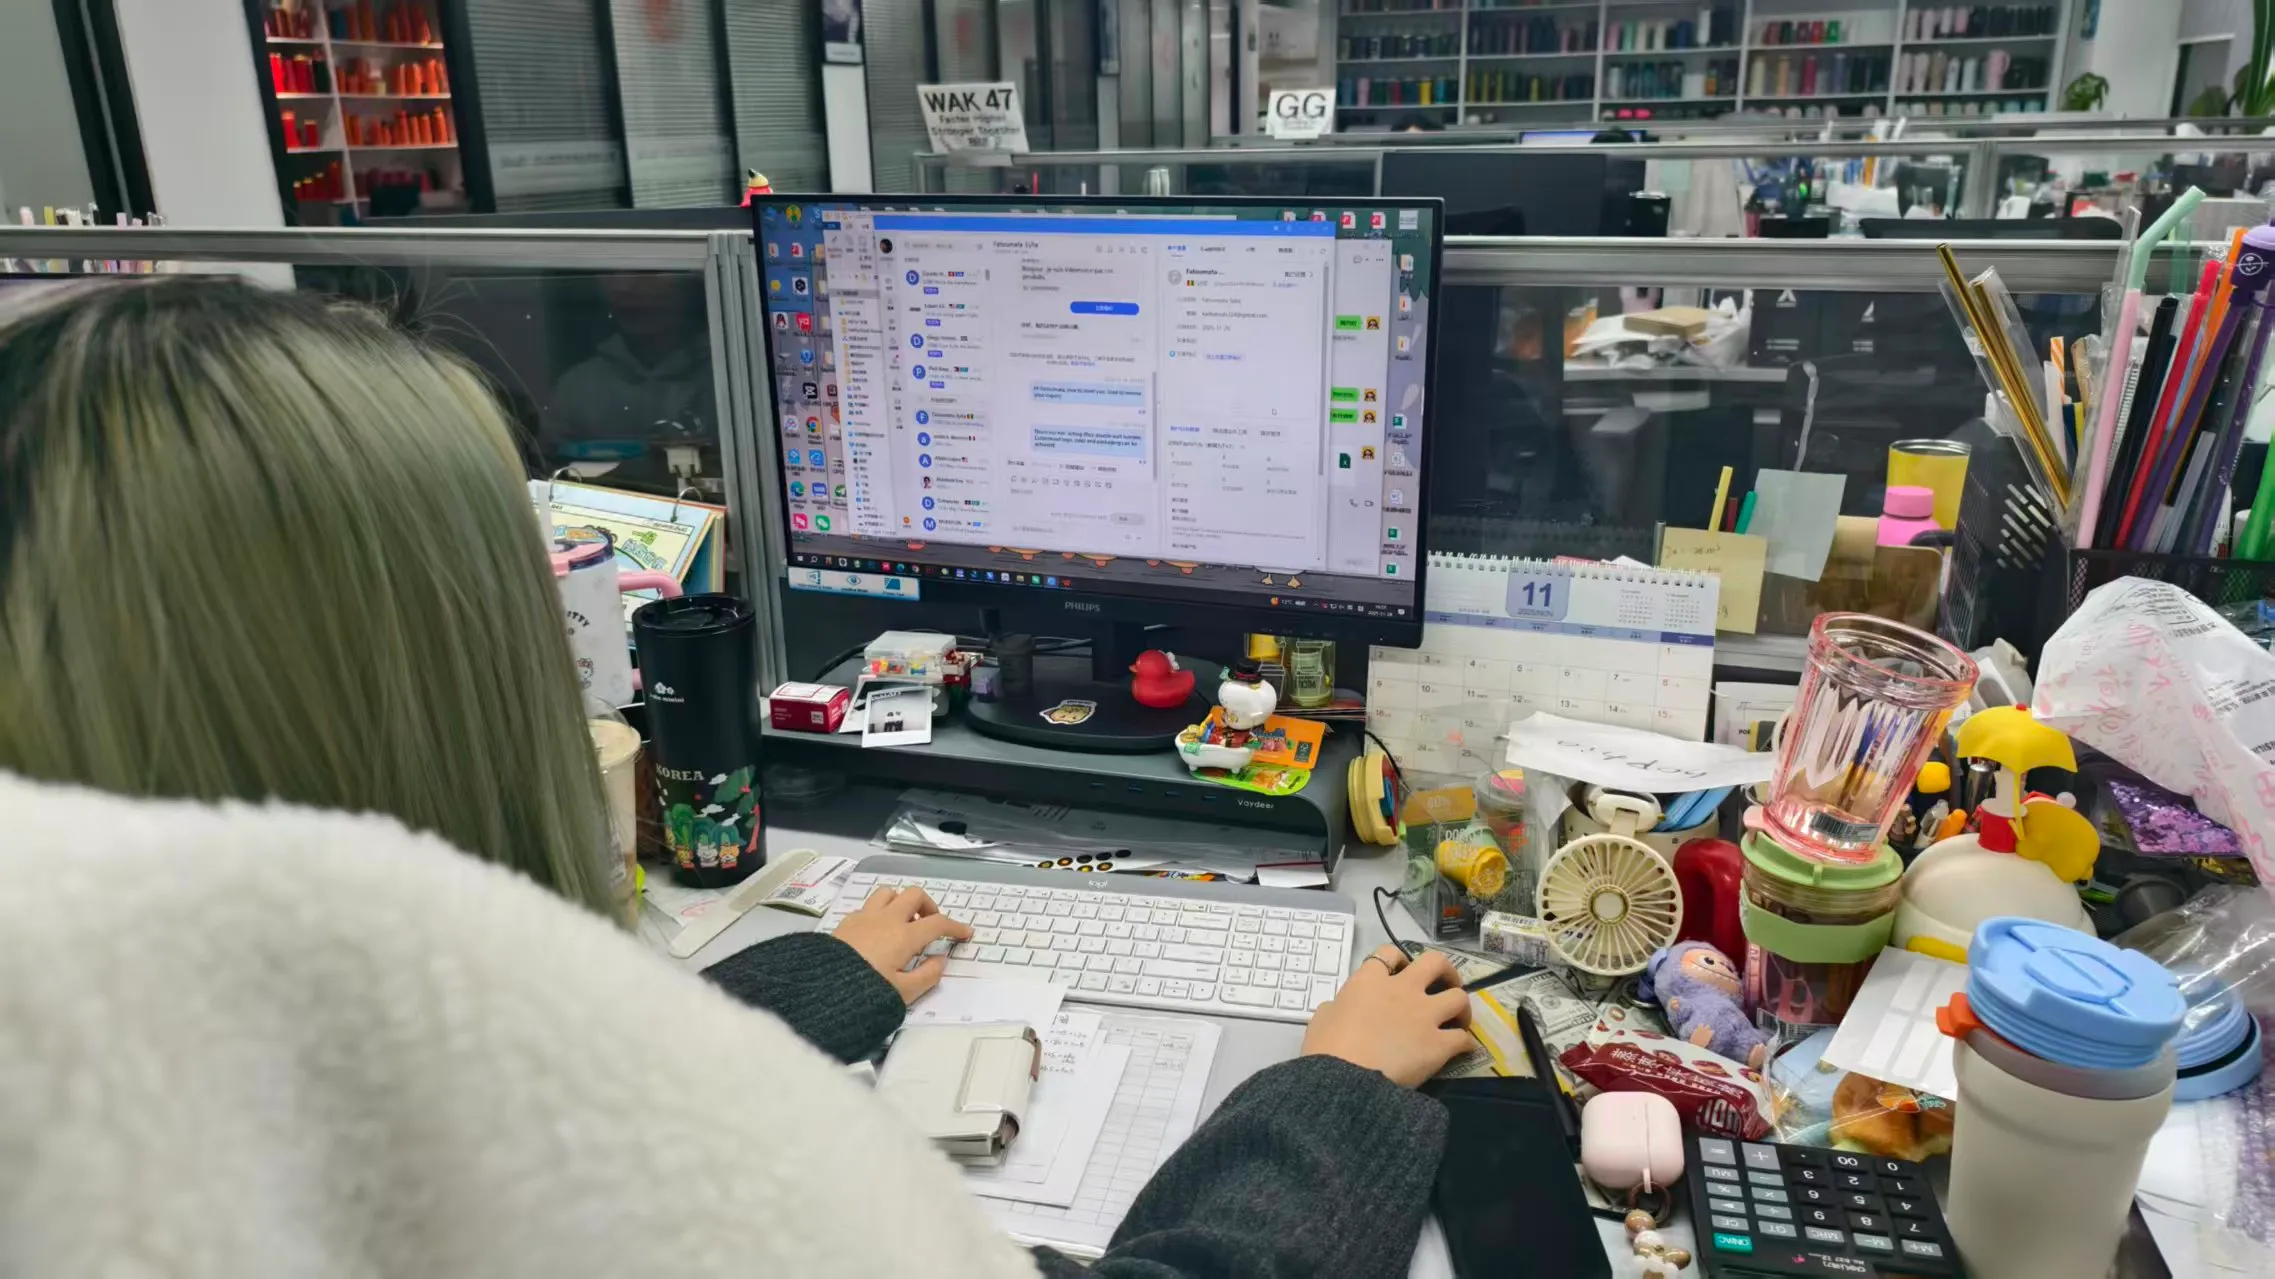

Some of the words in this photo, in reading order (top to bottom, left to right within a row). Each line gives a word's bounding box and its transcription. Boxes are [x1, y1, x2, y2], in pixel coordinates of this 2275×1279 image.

[924, 92, 980, 112] WAK
[985, 89, 1013, 111] 47
[1276, 92, 1326, 119] GG
[1522, 581, 1552, 608] 11
[1065, 602, 1100, 612] PHILIPS
[1421, 685, 1431, 693] 10
[1512, 695, 1522, 703] 12
[1560, 700, 1570, 708] 13
[1608, 705, 1618, 713] 14
[656, 764, 704, 781] KOREA
[1837, 1156, 1858, 1166] 00
[1712, 1169, 1731, 1177] MU
[1803, 1170, 1814, 1179] 3
[1848, 1177, 1859, 1185] 2
[1897, 1182, 1904, 1190] 1
[1808, 1190, 1819, 1199] 6
[1854, 1196, 1866, 1205] 5
[1901, 1202, 1911, 1210] 4
[1814, 1211, 1825, 1220] 9
[1861, 1217, 1872, 1226] 8
[1770, 1225, 1786, 1234] GT
[1910, 1224, 1920, 1232] 7
[1811, 1229, 1838, 1240] MRC
